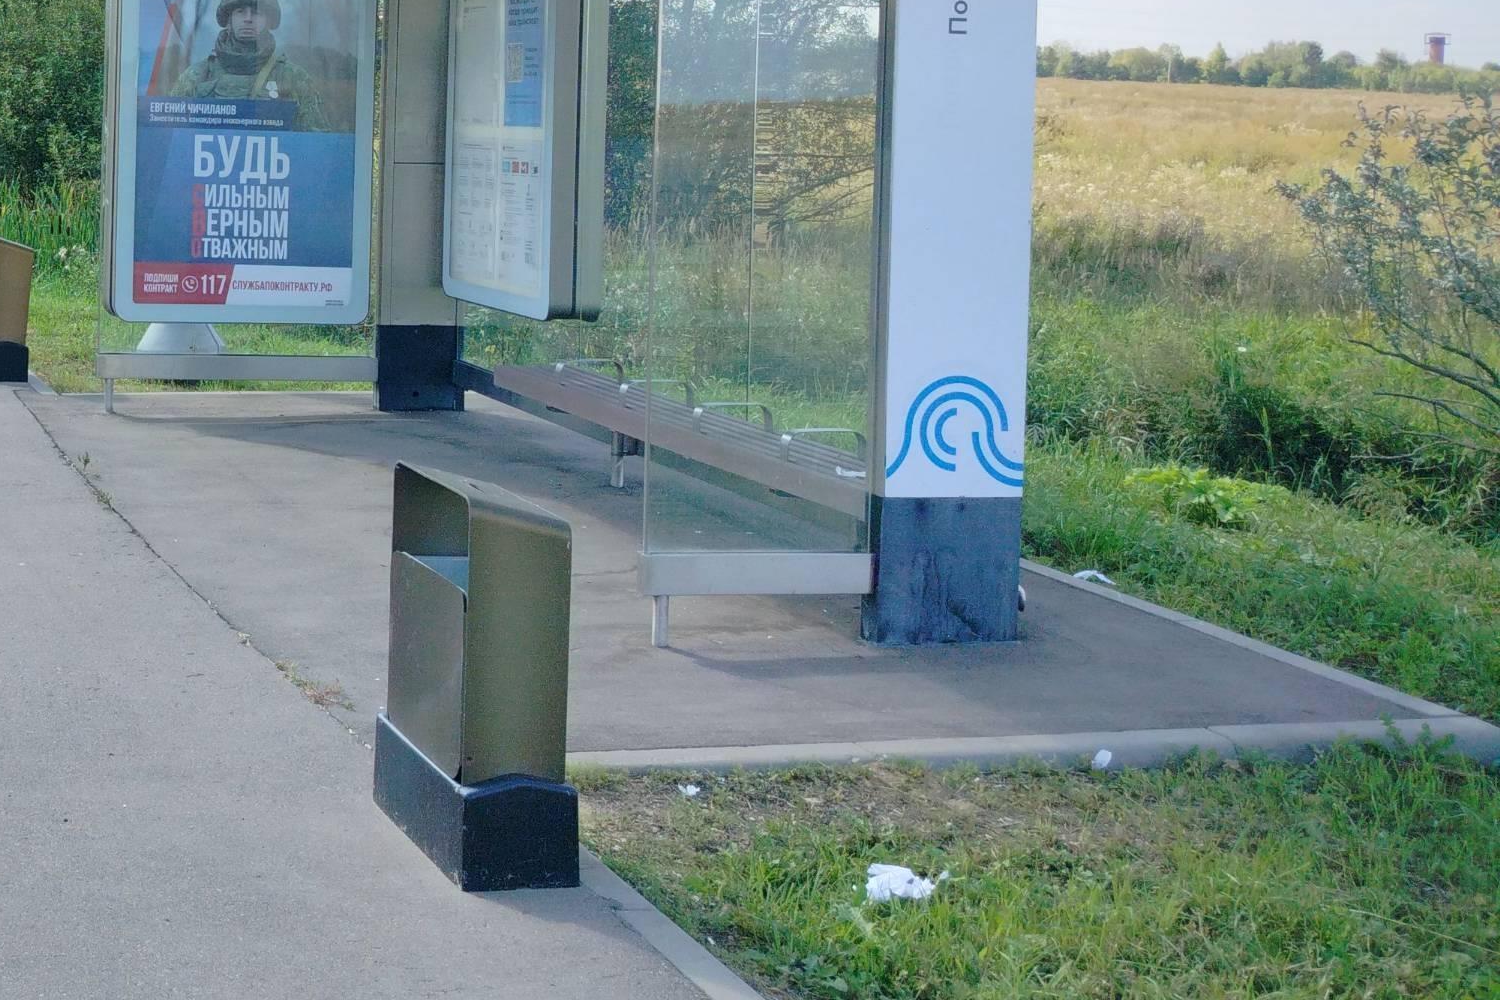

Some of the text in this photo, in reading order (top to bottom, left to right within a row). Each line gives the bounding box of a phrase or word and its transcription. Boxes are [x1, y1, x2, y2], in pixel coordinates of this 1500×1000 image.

[150, 101, 237, 116] ЕВГЕНИЙ ЧИЧИЛАНОВ
[194, 134, 290, 184] БУДЬ
[192, 184, 289, 209] СИЛЬНЫМ
[192, 208, 288, 238] ВЕРНЫМ
[191, 238, 288, 260] ОТВАЖНЫМ
[144, 273, 179, 283] ПОДПИШИ
[144, 283, 178, 294] КОНТРАКТ
[201, 274, 227, 295] 117
[232, 280, 332, 293] СЛУЖБАПОКОНТРАКТУ.РФ
